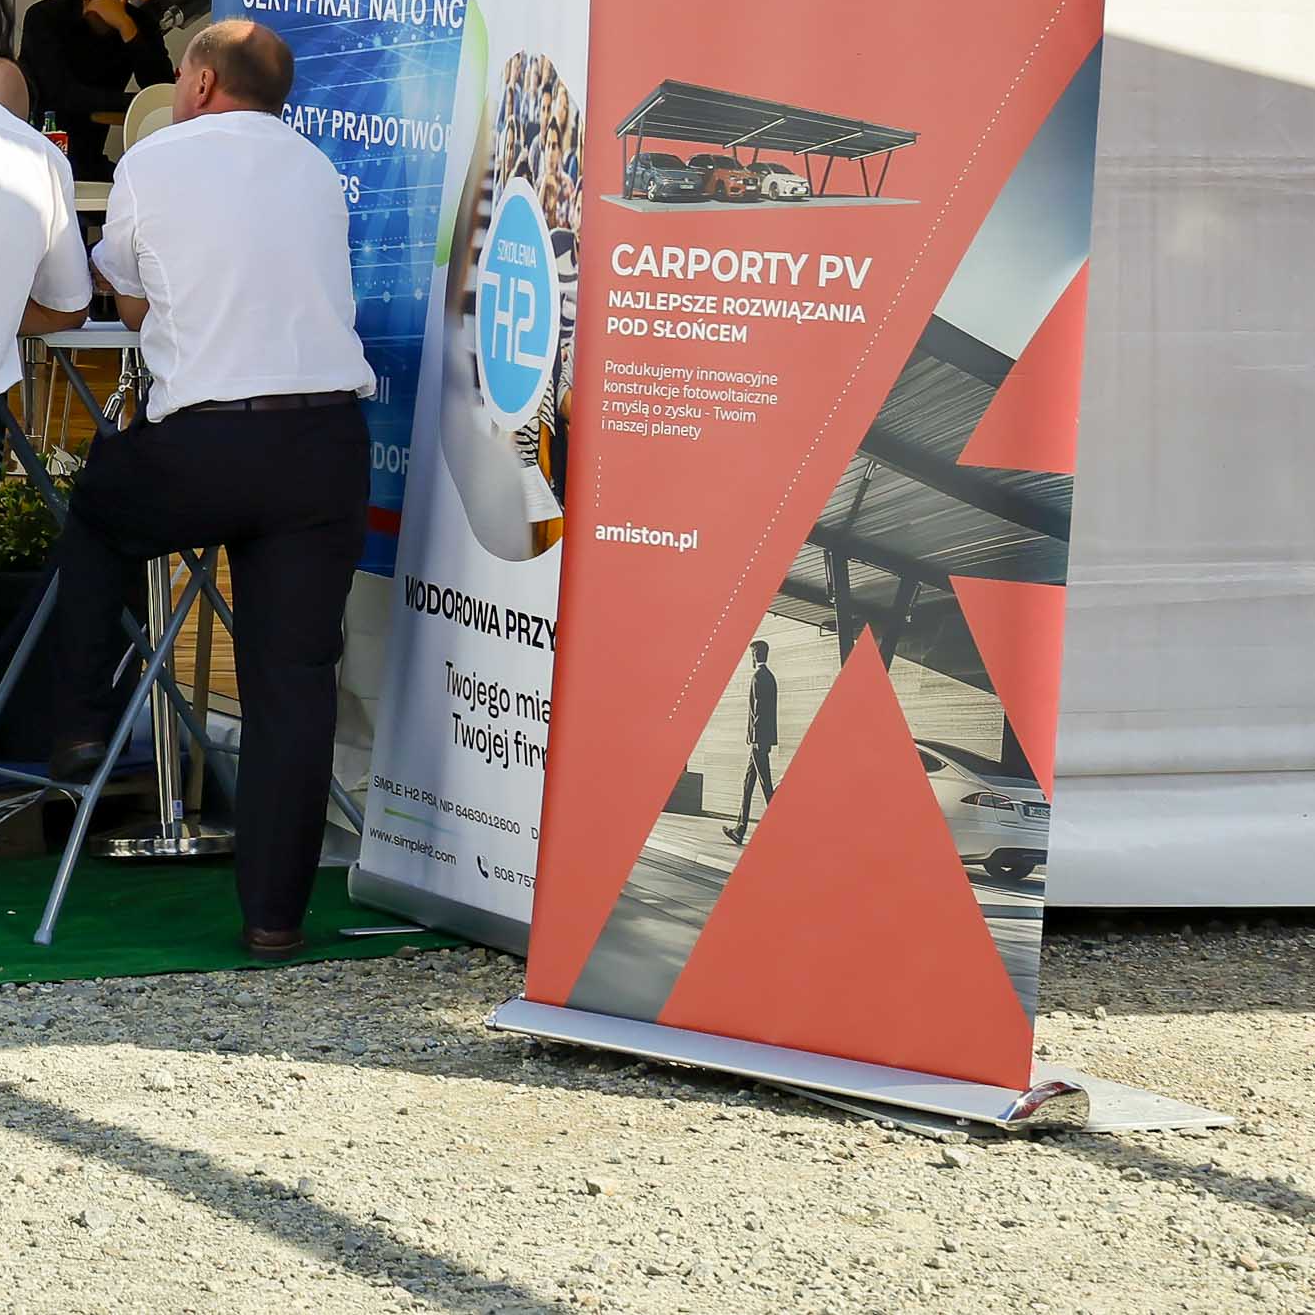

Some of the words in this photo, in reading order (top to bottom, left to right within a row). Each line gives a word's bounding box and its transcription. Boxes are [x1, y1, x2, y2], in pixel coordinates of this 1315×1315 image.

[281, 103, 328, 137] GATY
[497, 238, 537, 268] SZKOLENIA
[611, 243, 809, 286] CARPORTY
[818, 254, 873, 290] PV
[608, 290, 717, 315] NAJLEPSZE
[723, 297, 866, 325] ROZWIĄZANIA
[606, 317, 648, 338] POD
[653, 317, 747, 343] SŁOŃCEM
[604, 360, 694, 382] Produkujemy
[697, 365, 778, 387] innowacyjne
[603, 380, 680, 399] konstrukcje
[683, 384, 778, 405] fotowoltaiczne
[602, 401, 609, 412] z
[611, 399, 650, 418] myślą
[653, 404, 661, 415] o
[664, 402, 702, 422] zysku
[712, 406, 756, 423] Twoim
[607, 419, 648, 436] naszej
[651, 422, 701, 441] planety
[595, 522, 698, 551] amiston.pl
[405, 575, 501, 637] WODOROWA
[446, 660, 510, 719] Twojego
[452, 712, 509, 769] Twojej
[374, 775, 402, 797] SIMPLE
[404, 786, 420, 802] H2
[439, 799, 454, 813] NIP
[455, 804, 520, 835] 6463012600
[370, 827, 457, 865] www.simpleh2.com
[494, 866, 515, 883] 608
